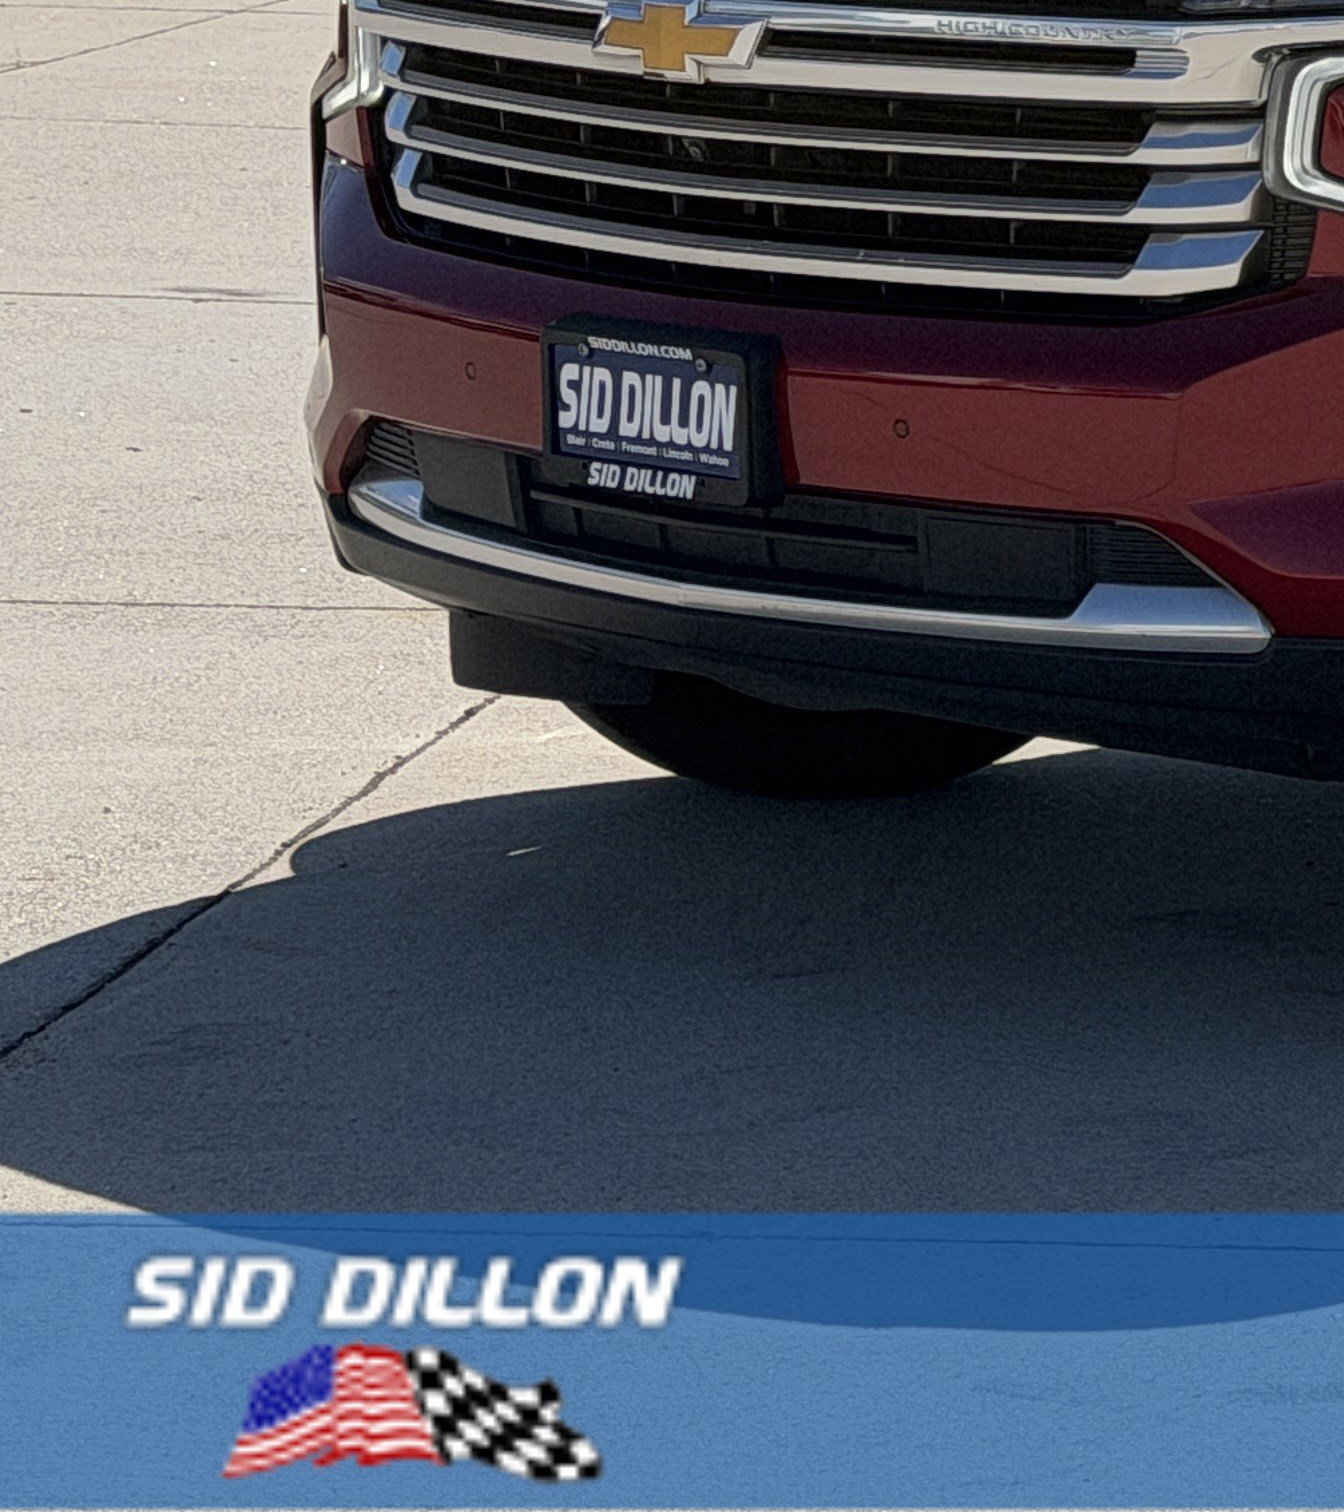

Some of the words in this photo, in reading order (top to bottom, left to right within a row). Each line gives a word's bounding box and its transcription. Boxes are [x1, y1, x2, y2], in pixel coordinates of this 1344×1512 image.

[936, 19, 998, 37] HIGH
[1007, 22, 1128, 41] COUNTRY
[587, 336, 693, 361] SIDDILLON.COM
[558, 363, 613, 434] SID
[619, 371, 737, 452] DILLON
[621, 441, 658, 457] Fremont
[663, 448, 693, 462] Lincoln
[588, 462, 620, 489] SID
[623, 467, 697, 500] DILLON
